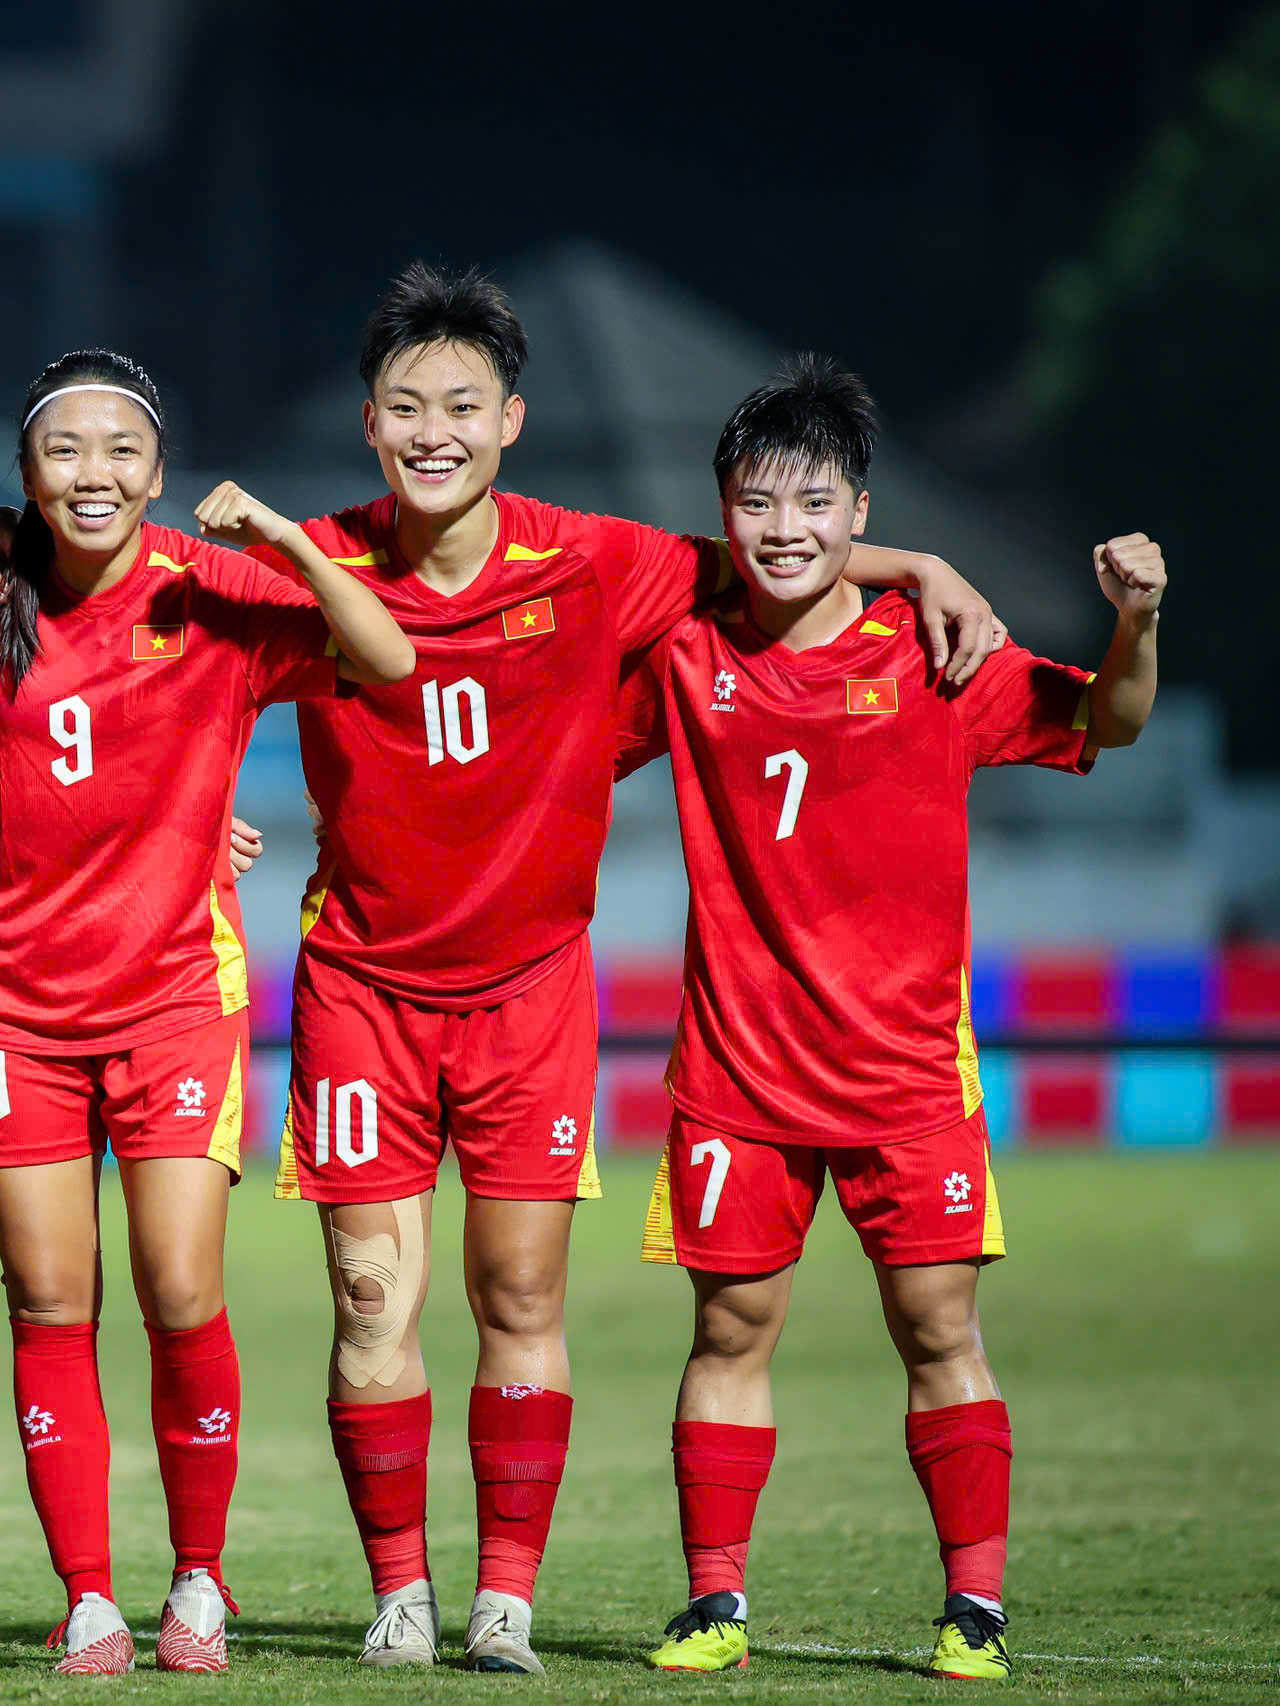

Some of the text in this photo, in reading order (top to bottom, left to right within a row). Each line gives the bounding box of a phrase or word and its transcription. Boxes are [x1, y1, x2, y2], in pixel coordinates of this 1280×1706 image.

[48, 694, 94, 787] 9
[421, 676, 495, 767] 10
[764, 748, 809, 841] 7
[315, 1077, 380, 1169] 10
[690, 1137, 732, 1229] 7
